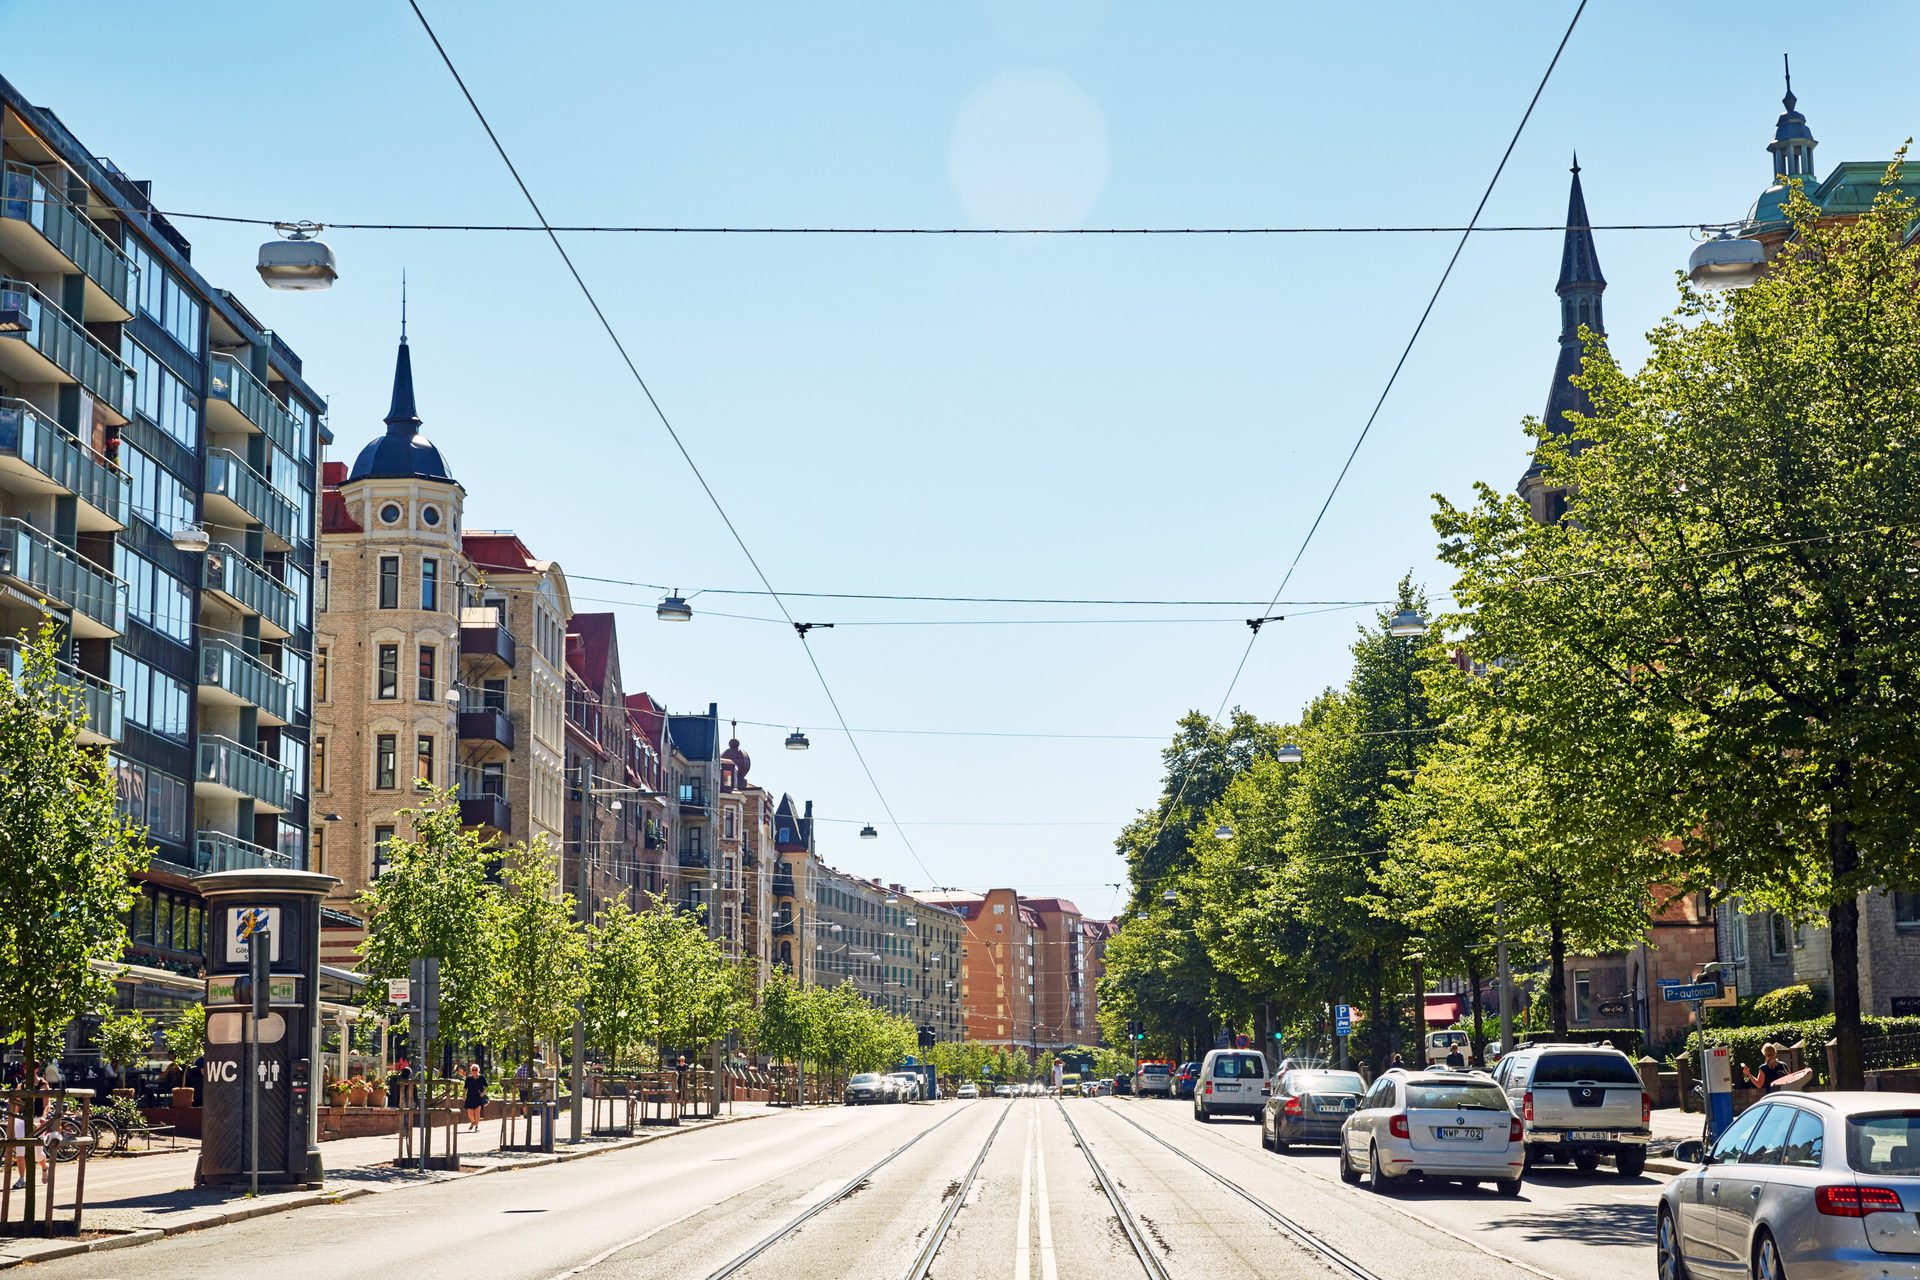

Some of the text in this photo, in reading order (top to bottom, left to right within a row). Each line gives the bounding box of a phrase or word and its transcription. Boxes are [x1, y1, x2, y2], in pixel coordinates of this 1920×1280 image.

[1339, 1006, 1347, 1017] P
[206, 1060, 238, 1082] WC
[1443, 1128, 1481, 1138] NWP 702
[1574, 1132, 1587, 1140] JLY
